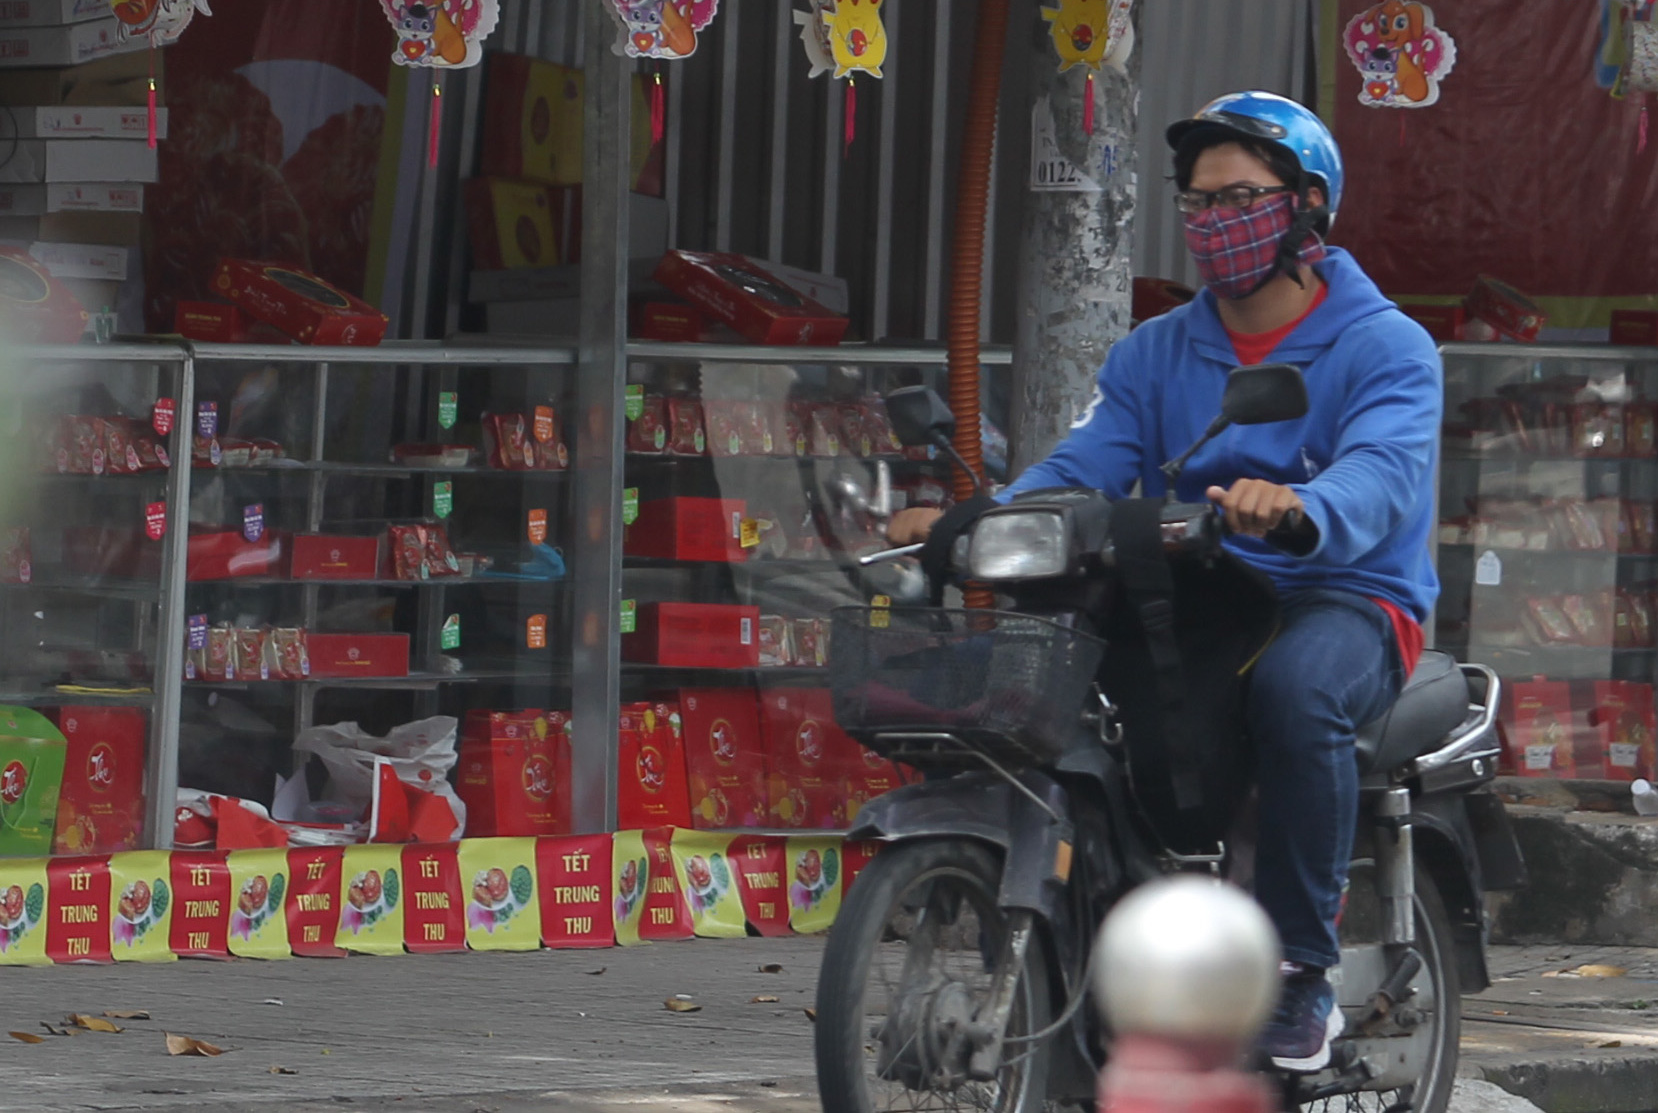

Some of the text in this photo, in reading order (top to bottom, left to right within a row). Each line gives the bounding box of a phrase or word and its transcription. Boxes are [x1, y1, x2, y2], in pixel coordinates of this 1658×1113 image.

[308, 857, 325, 879] TẾT
[420, 857, 439, 877] TẾT
[562, 849, 590, 872] TẾT
[69, 867, 91, 890] TẾT
[188, 864, 211, 885] TẾT
[744, 873, 777, 888] TRUNG
[297, 894, 329, 911] TRUNG
[416, 893, 449, 908] TRUNG
[554, 886, 599, 903] TRUNG
[61, 905, 97, 922] TRUNG
[186, 901, 219, 917] TRUNG
[651, 908, 673, 923] THU
[759, 903, 774, 918] THU
[304, 926, 319, 941] THU
[424, 924, 444, 940] THU
[565, 917, 591, 934] THU
[68, 938, 89, 955] THU
[189, 933, 208, 948] THU
